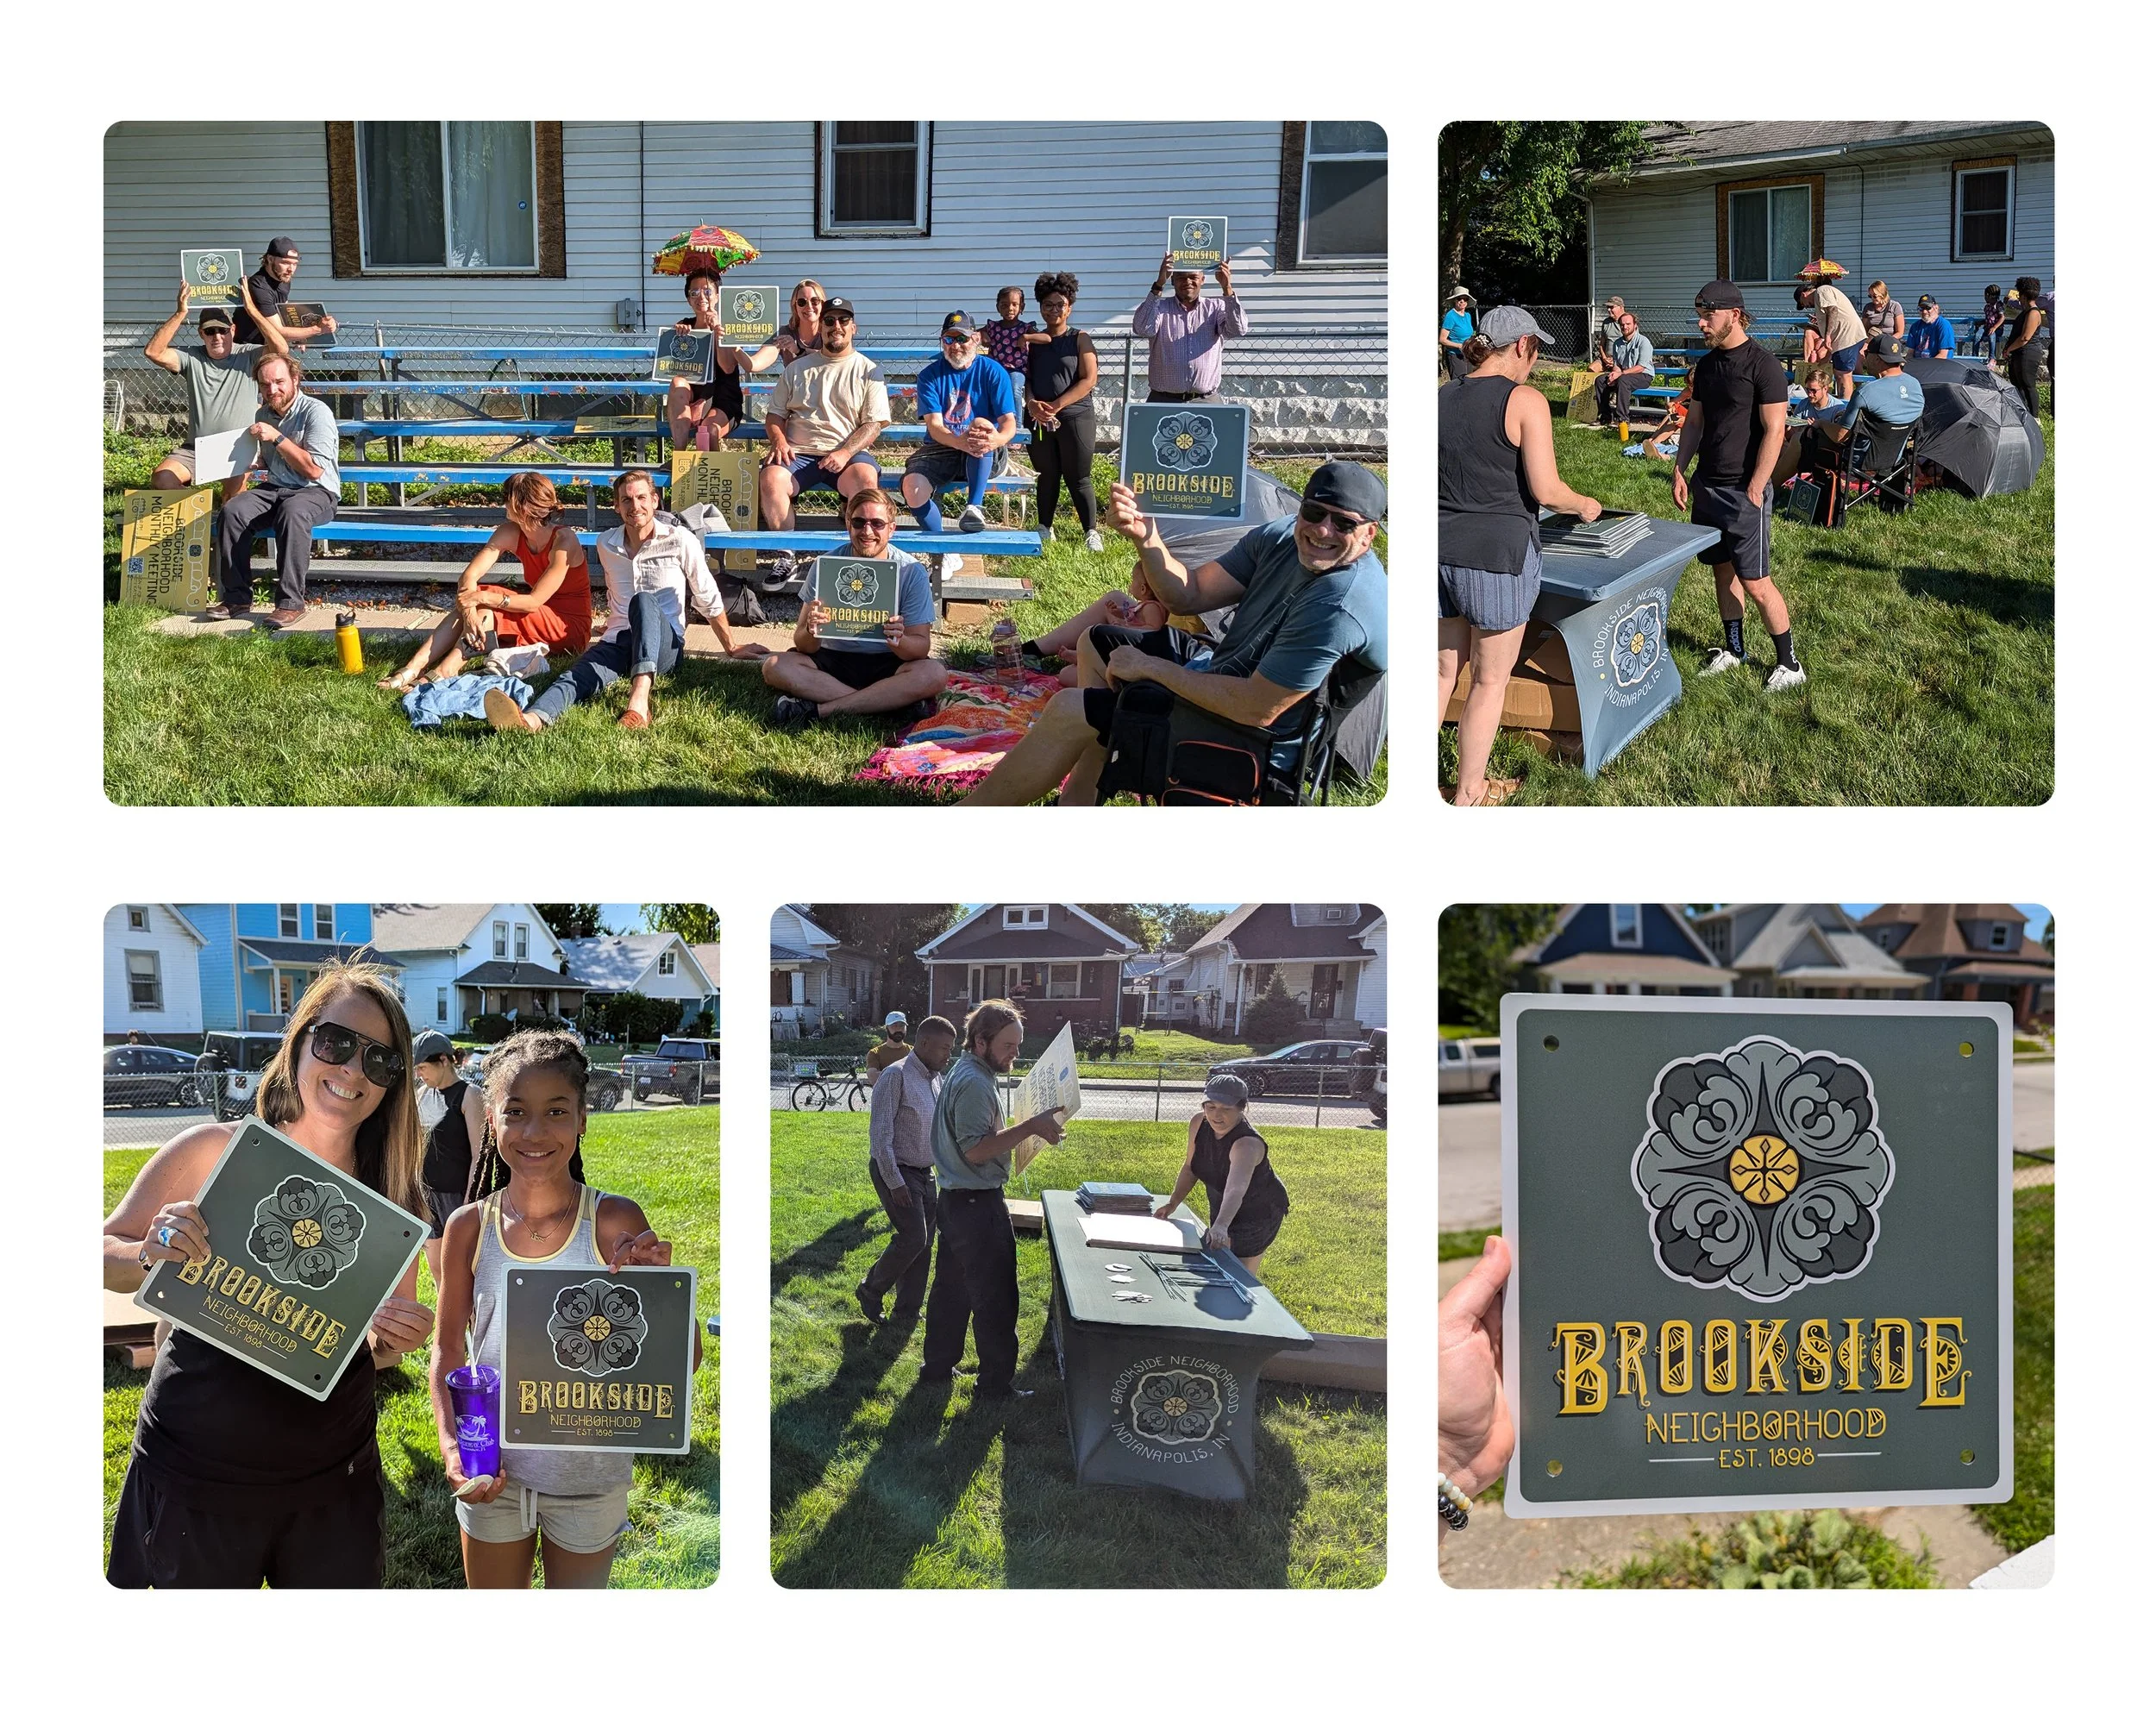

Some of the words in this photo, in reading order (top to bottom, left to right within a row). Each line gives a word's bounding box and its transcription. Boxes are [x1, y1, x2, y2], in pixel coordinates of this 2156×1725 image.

[1173, 250, 1220, 261] BROOKSIDE
[725, 323, 774, 336] BROOKSIDE
[659, 360, 704, 374] BROOKSIDE
[697, 457, 708, 505] MONTHL
[709, 468, 720, 506] NEIGHB
[1131, 473, 1236, 499] BROOKSIDE
[1152, 494, 1213, 504] NEIGHBORHOOD
[721, 479, 732, 526] BROOKS
[149, 496, 162, 549] MONTHLY
[160, 507, 173, 594] NEIGHBORHOOD
[172, 518, 185, 581] BROOKSIDE
[146, 553, 160, 605] MEETING
[823, 607, 890, 625] BROOKSIDE
[1593, 598, 1633, 668] BROOKSIDE
[1635, 586, 1668, 629] NEIGHBORHOOD
[1660, 648, 1670, 662] IN
[1728, 626, 1742, 653] adidas
[176, 1252, 347, 1359] BROOKSIDE
[202, 1295, 298, 1353] NEIGHBORHOOD
[224, 1323, 243, 1340] EST.
[242, 1333, 263, 1349] 1898
[1111, 1356, 1165, 1404] BROOKSIDE
[1170, 1355, 1239, 1414] NEIGHBORHOOD
[1549, 1317, 1973, 1416] BROOKSIDE
[517, 1380, 676, 1420] BROOKSIDE
[550, 1414, 642, 1428] NEIGHBORHOOD
[595, 1428, 614, 1438] 1898
[1645, 1408, 1887, 1445] NEIGHBORHOOD
[1111, 1422, 1214, 1464] INDIANAPOLIS,
[1212, 1433, 1232, 1449] IN
[1719, 1448, 1764, 1469] EST.
[1769, 1447, 1816, 1467] 1898
